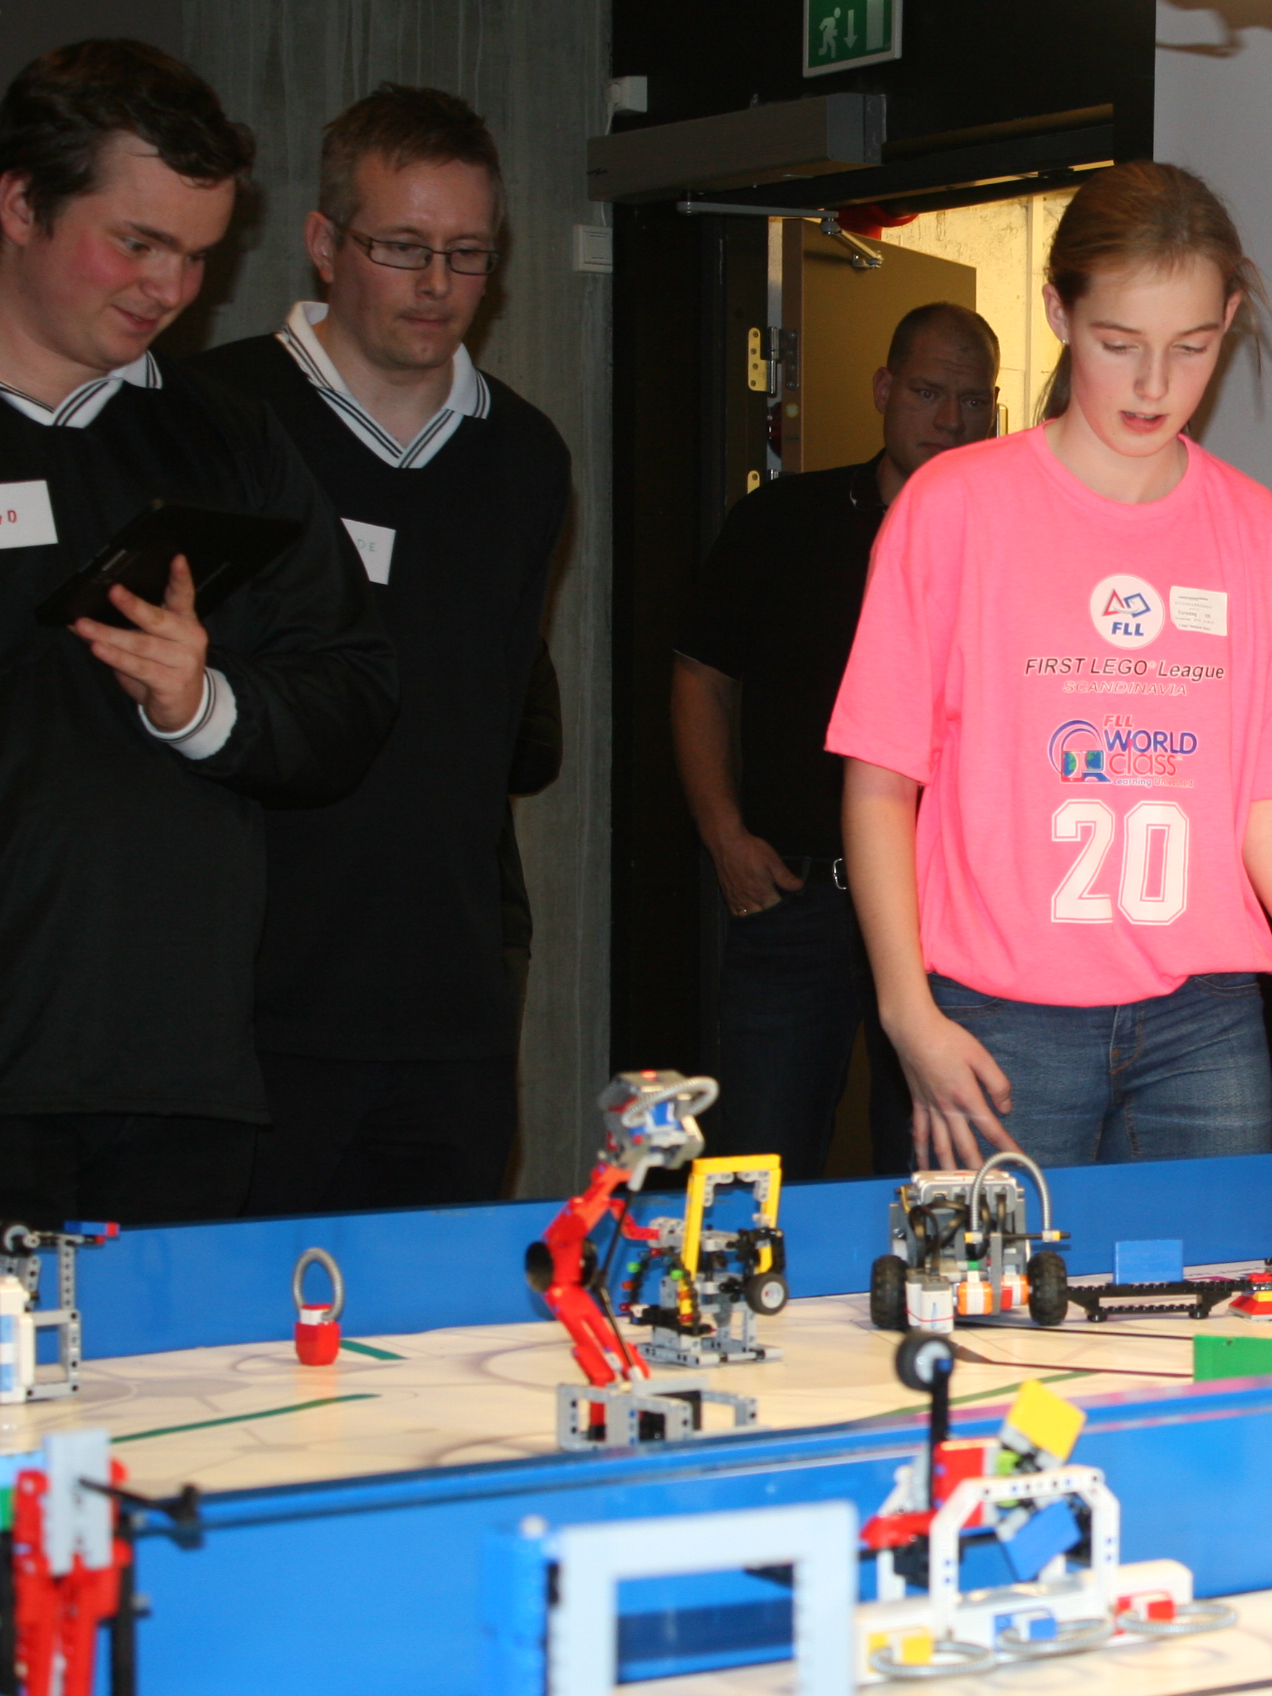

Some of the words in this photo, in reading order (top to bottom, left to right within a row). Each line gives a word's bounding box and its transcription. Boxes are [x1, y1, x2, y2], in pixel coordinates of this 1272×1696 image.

[1111, 621, 1145, 636] FLL
[1025, 657, 1087, 676] FIRST
[1157, 660, 1226, 682] League
[1062, 680, 1188, 697] SCANDINAVIA
[1103, 714, 1134, 728] FLL
[1103, 729, 1198, 755] WORLD
[1108, 738, 1178, 777] class
[1113, 777, 1152, 788] Learning
[1051, 798, 1190, 926] 20
